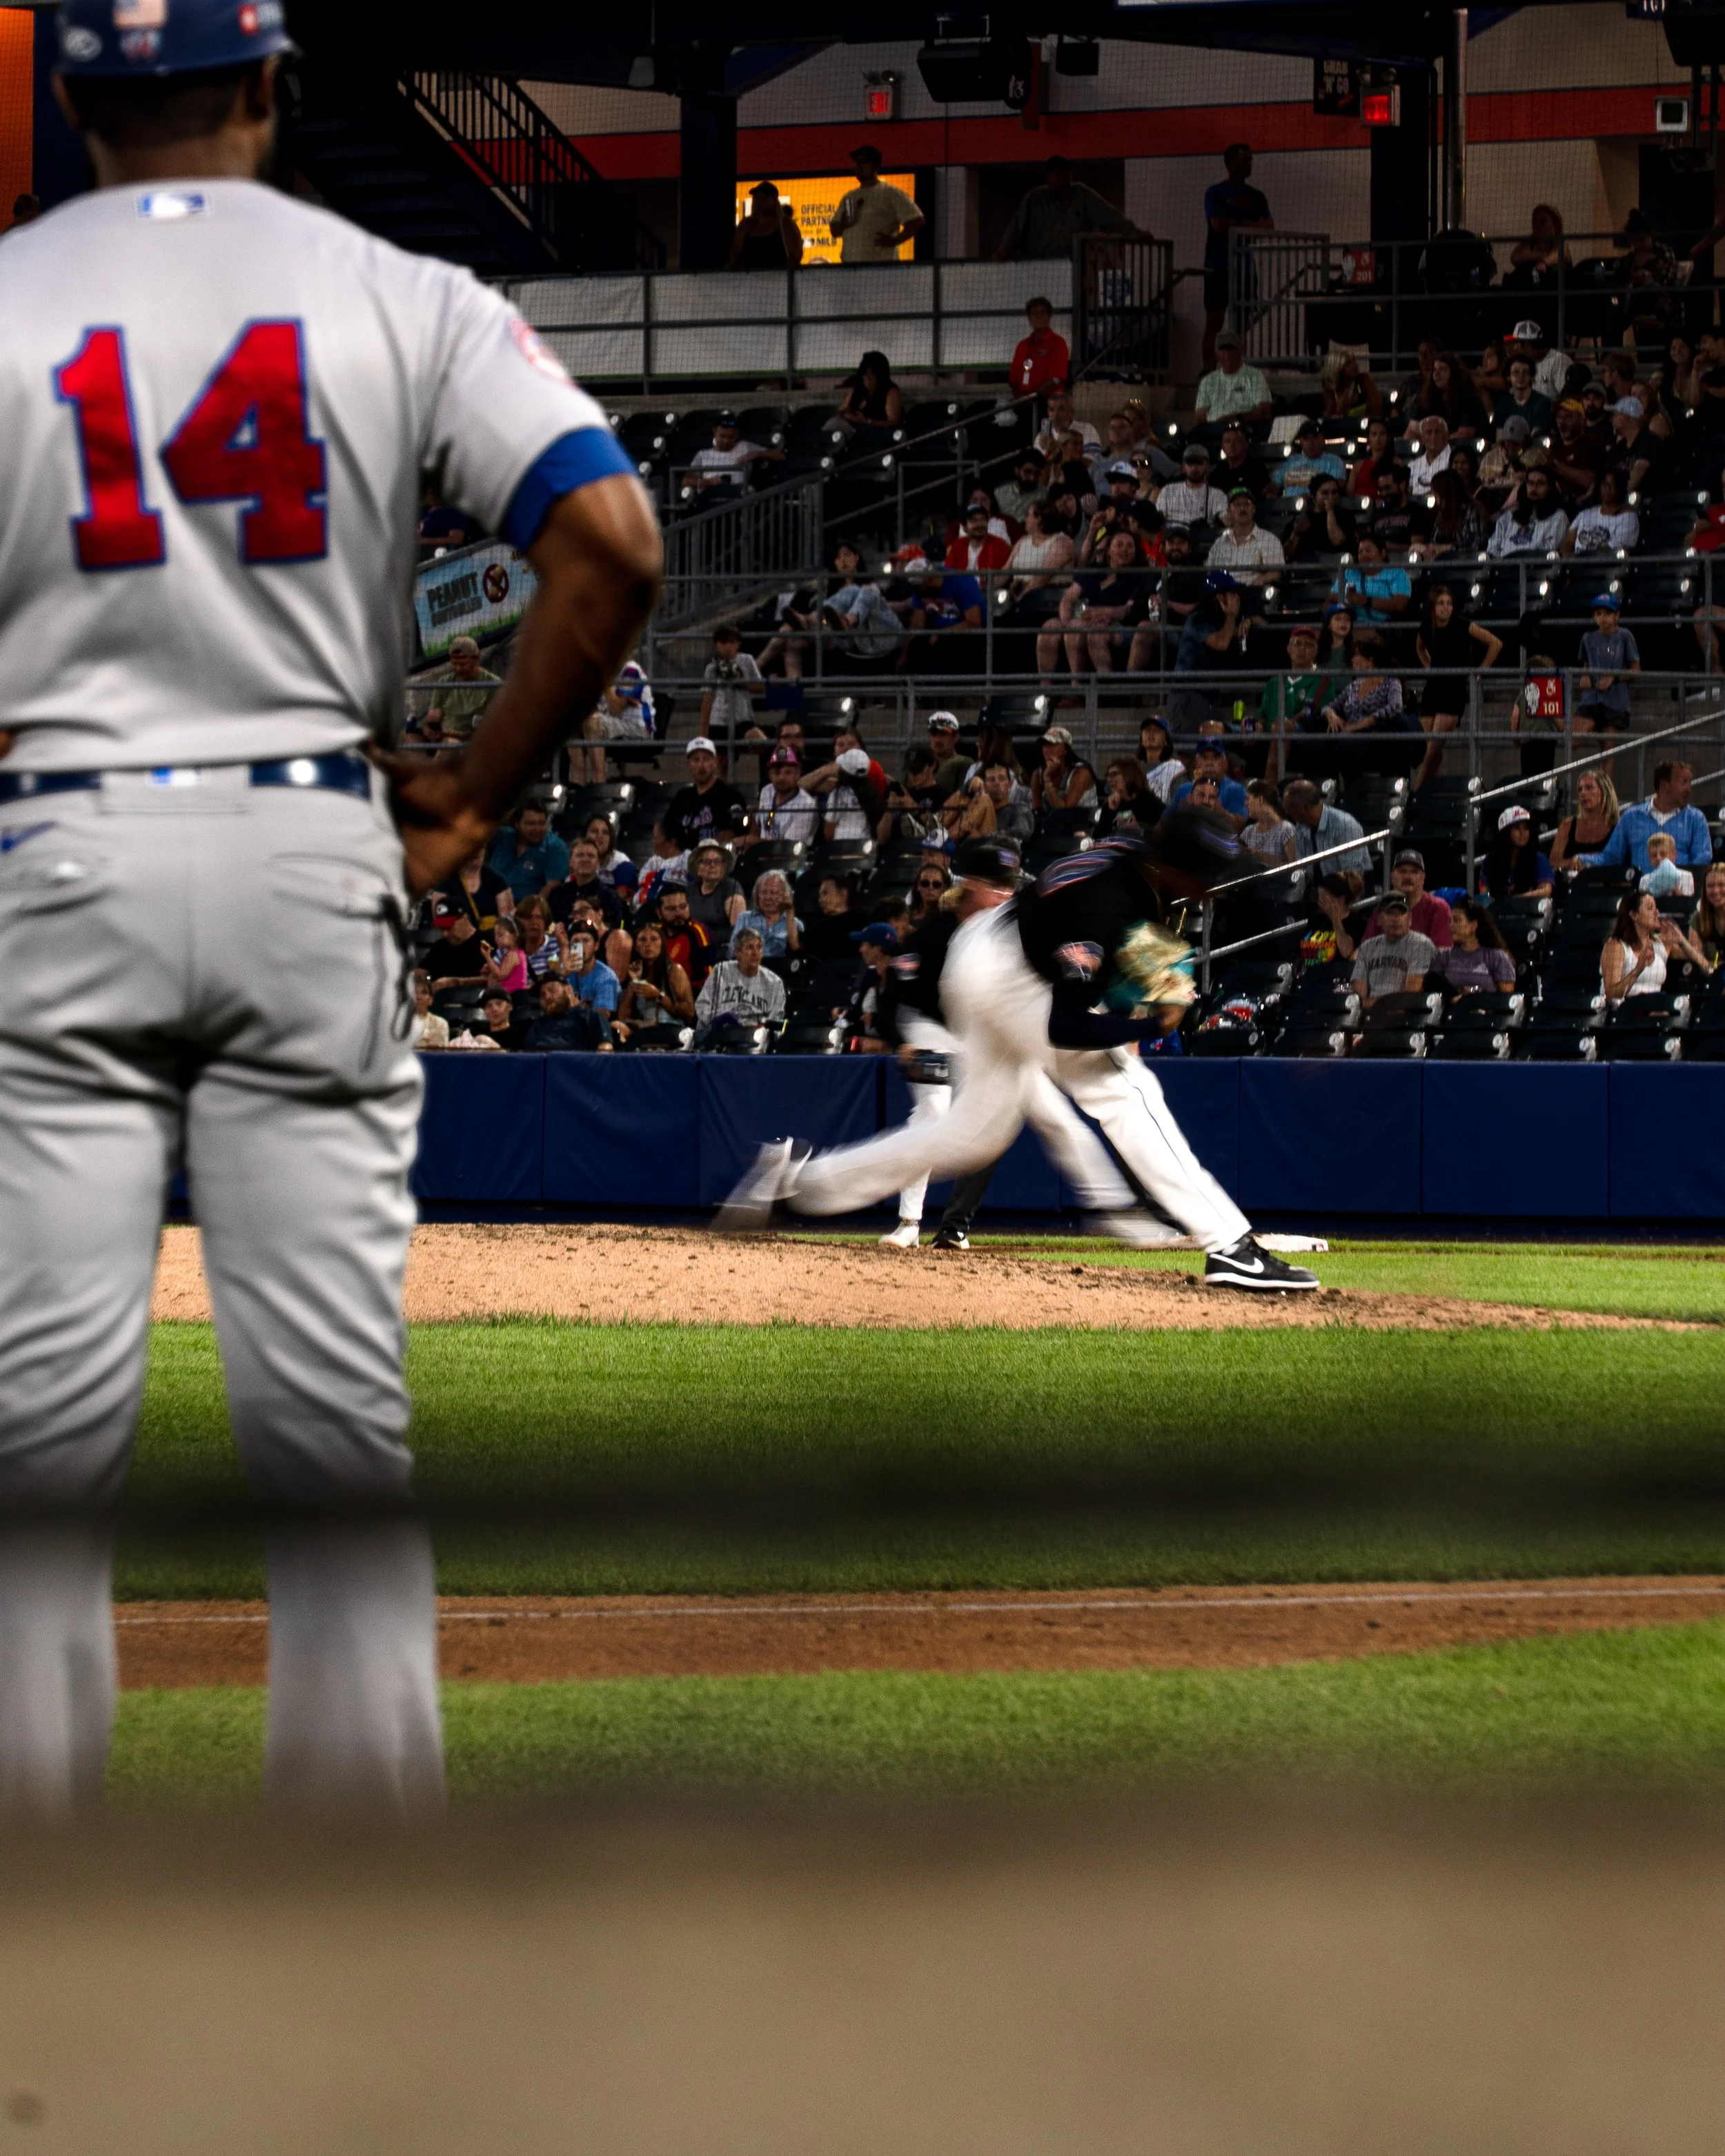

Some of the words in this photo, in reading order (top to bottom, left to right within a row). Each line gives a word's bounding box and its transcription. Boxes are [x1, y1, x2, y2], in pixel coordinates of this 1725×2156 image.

[801, 204, 836, 215] OFFICIAL
[1356, 270, 1372, 282] 201
[51, 317, 330, 572] 14
[426, 571, 478, 613] PEANUT
[1543, 700, 1559, 715] 101
[721, 985, 769, 1012] CLEVELAND
